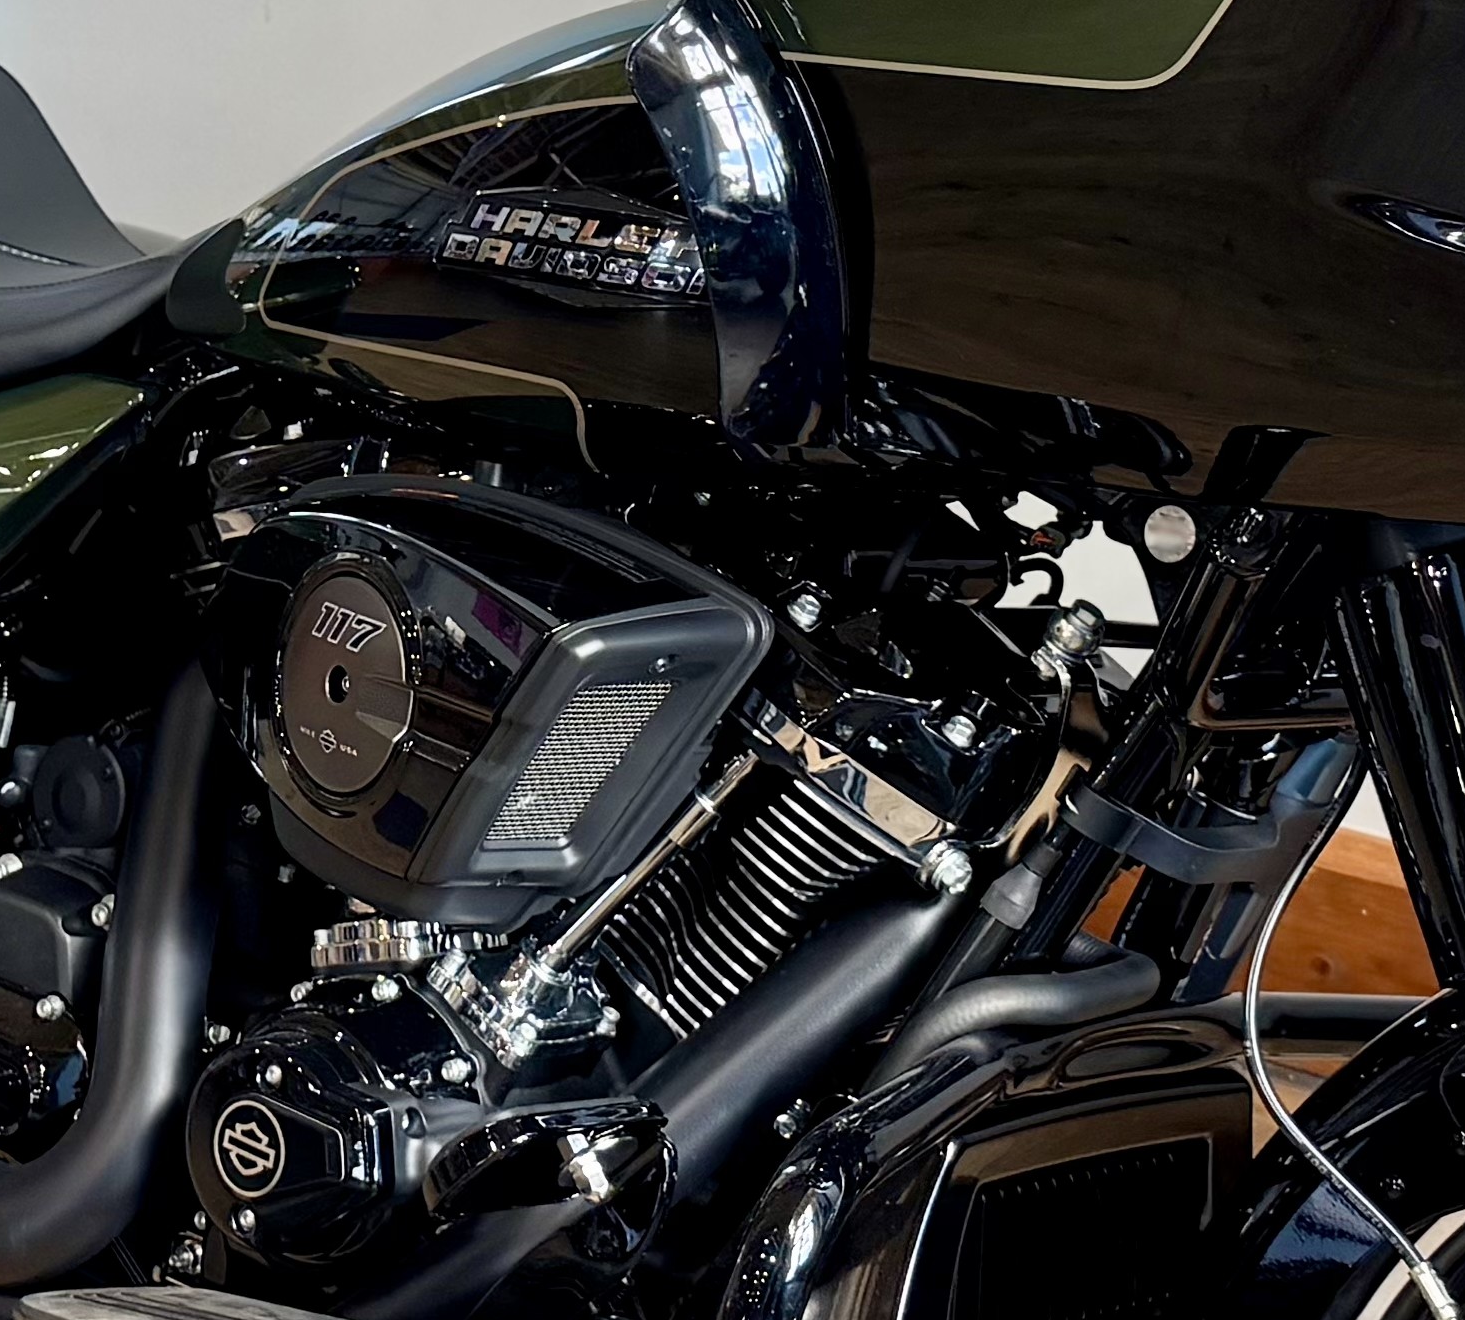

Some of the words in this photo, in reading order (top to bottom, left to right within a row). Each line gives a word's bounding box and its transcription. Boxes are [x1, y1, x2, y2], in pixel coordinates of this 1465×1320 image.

[470, 203, 700, 262] HARLEY
[311, 601, 387, 653] 117
[339, 744, 358, 757] USA
